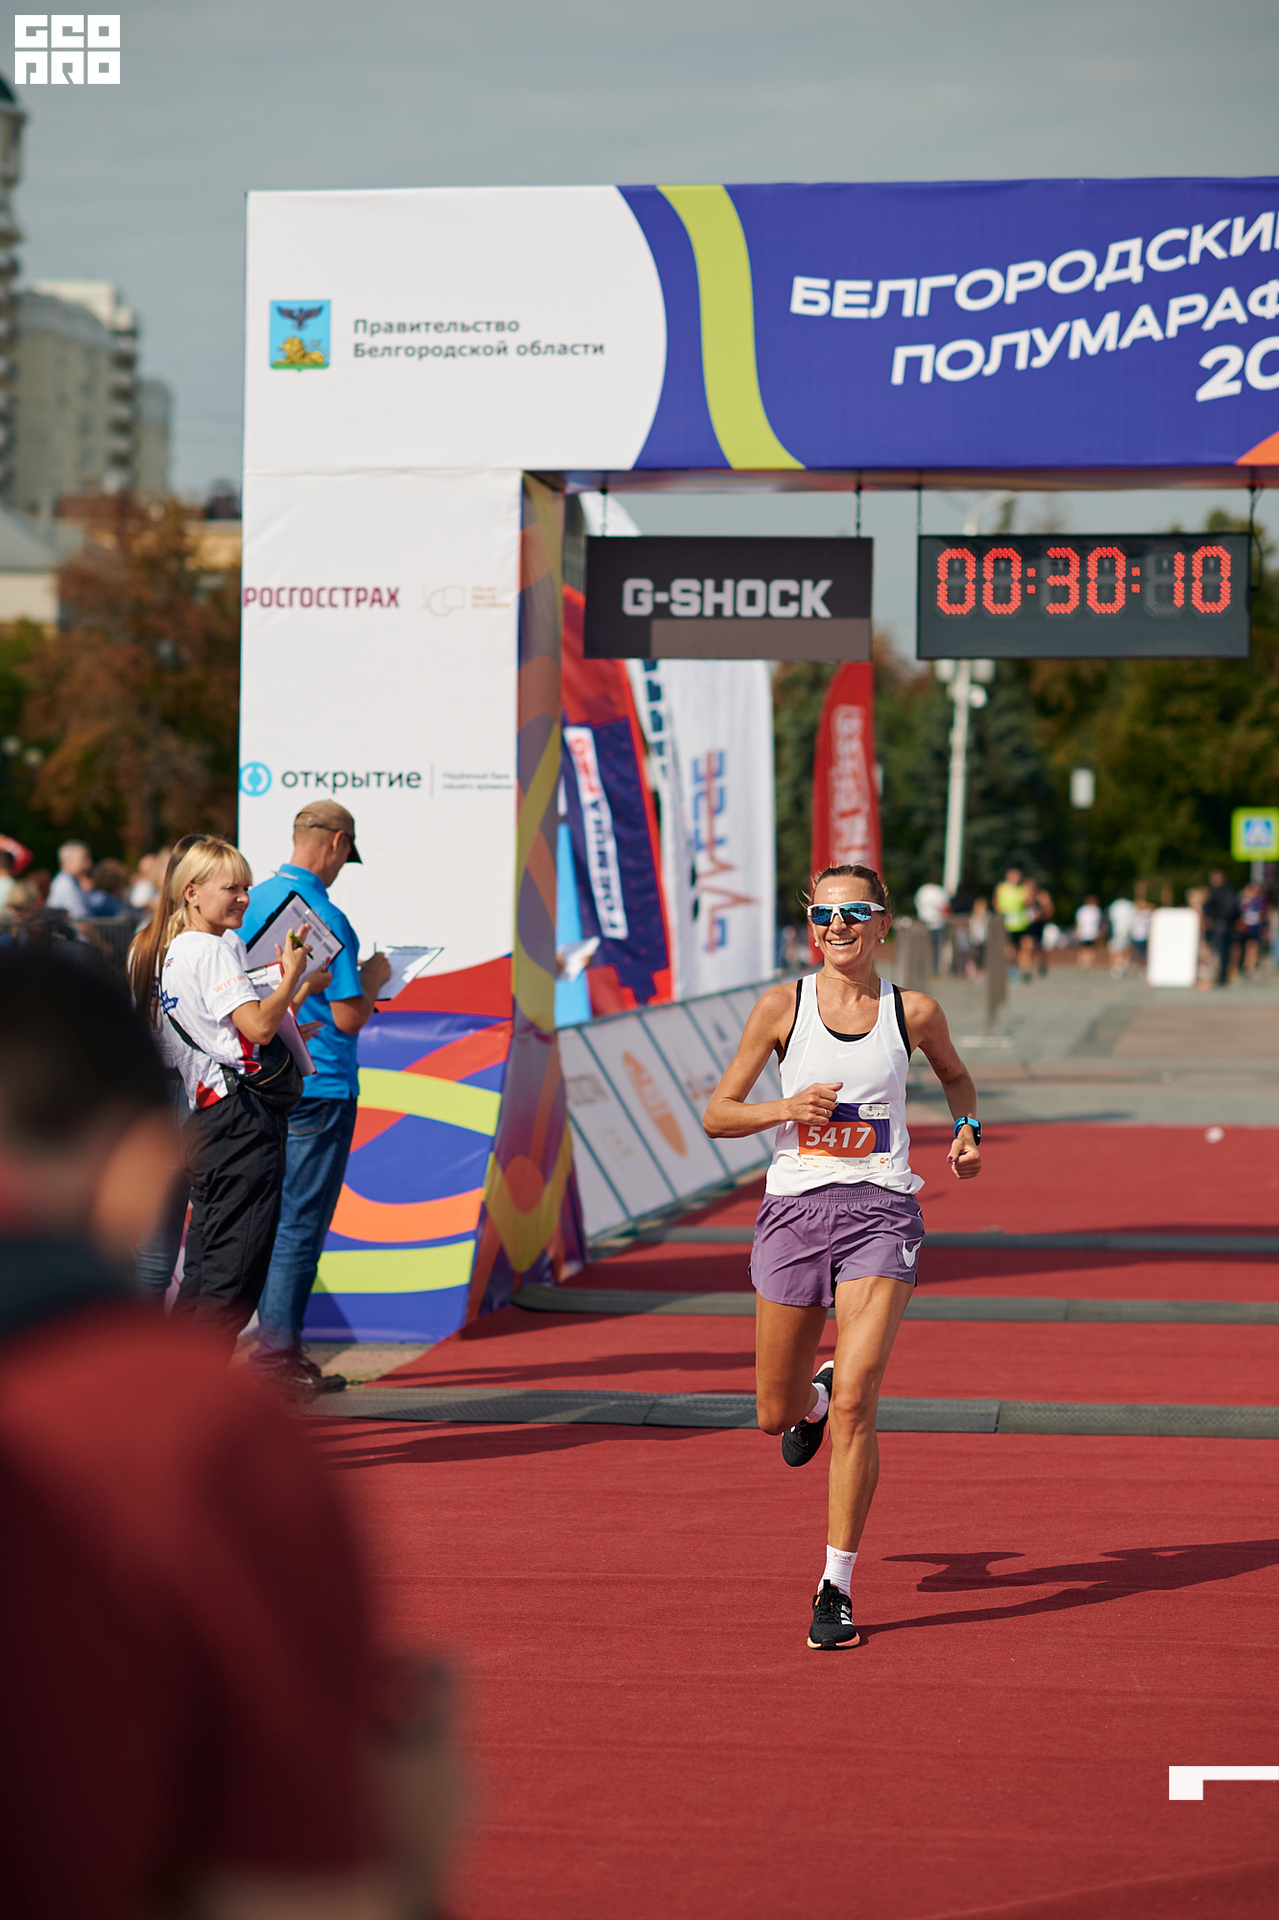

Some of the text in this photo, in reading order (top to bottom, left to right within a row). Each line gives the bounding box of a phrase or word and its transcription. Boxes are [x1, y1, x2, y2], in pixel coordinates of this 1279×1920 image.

[789, 211, 1279, 319] БЕЛГОРОДСКИ
[353, 319, 520, 337] Правительство
[891, 278, 1279, 386] ПОЛУМАРАФ
[353, 340, 605, 361] Белгородской области
[937, 546, 1232, 614] 00:30:10
[242, 586, 400, 609] РОСГОССТРАХ
[622, 577, 833, 619] G-SHOCK
[281, 770, 423, 795] открытие
[805, 1126, 872, 1150] 5417
